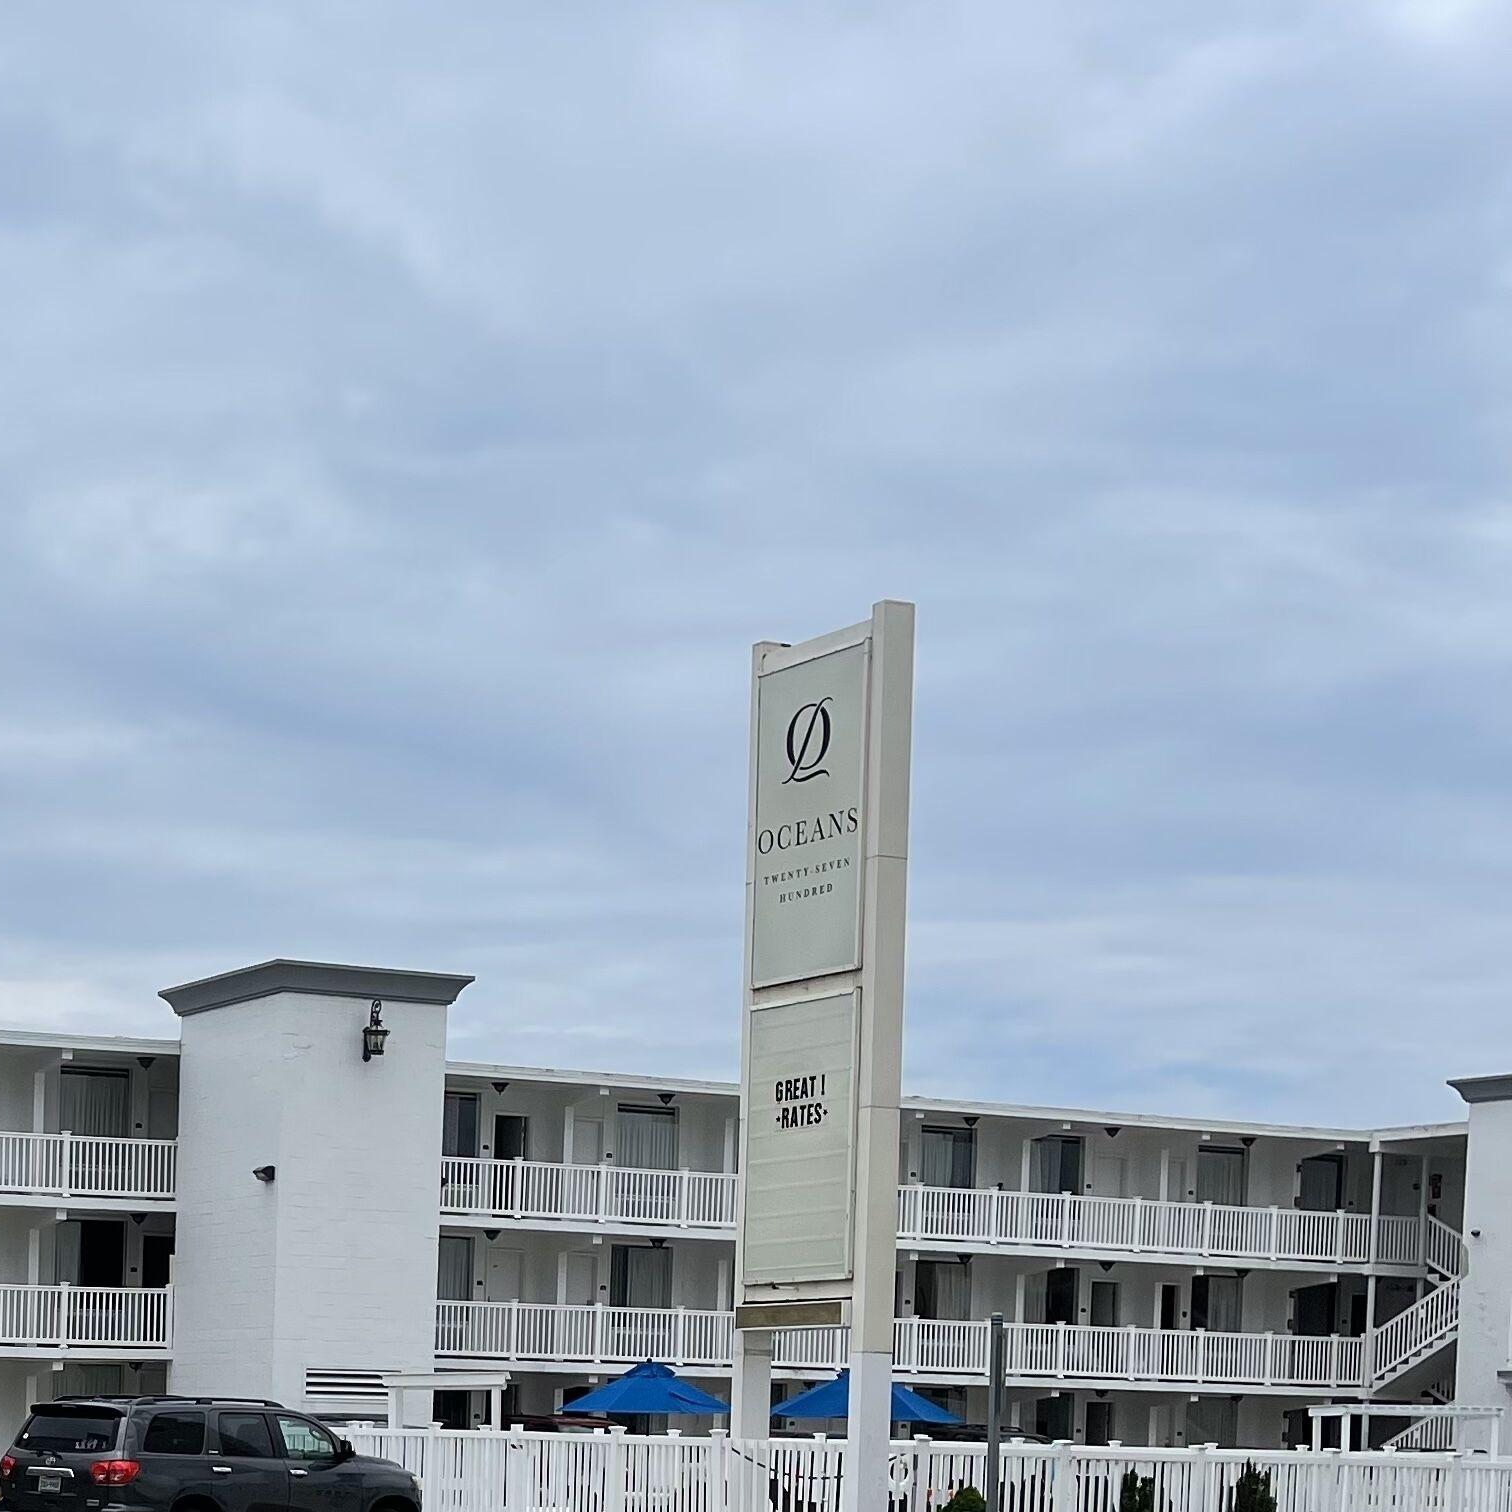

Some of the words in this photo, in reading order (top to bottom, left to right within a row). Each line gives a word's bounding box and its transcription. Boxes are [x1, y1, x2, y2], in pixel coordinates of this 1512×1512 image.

[758, 807, 858, 855] OCEANS
[779, 883, 833, 904] HUNDRED
[775, 1075, 817, 1103] GREAT
